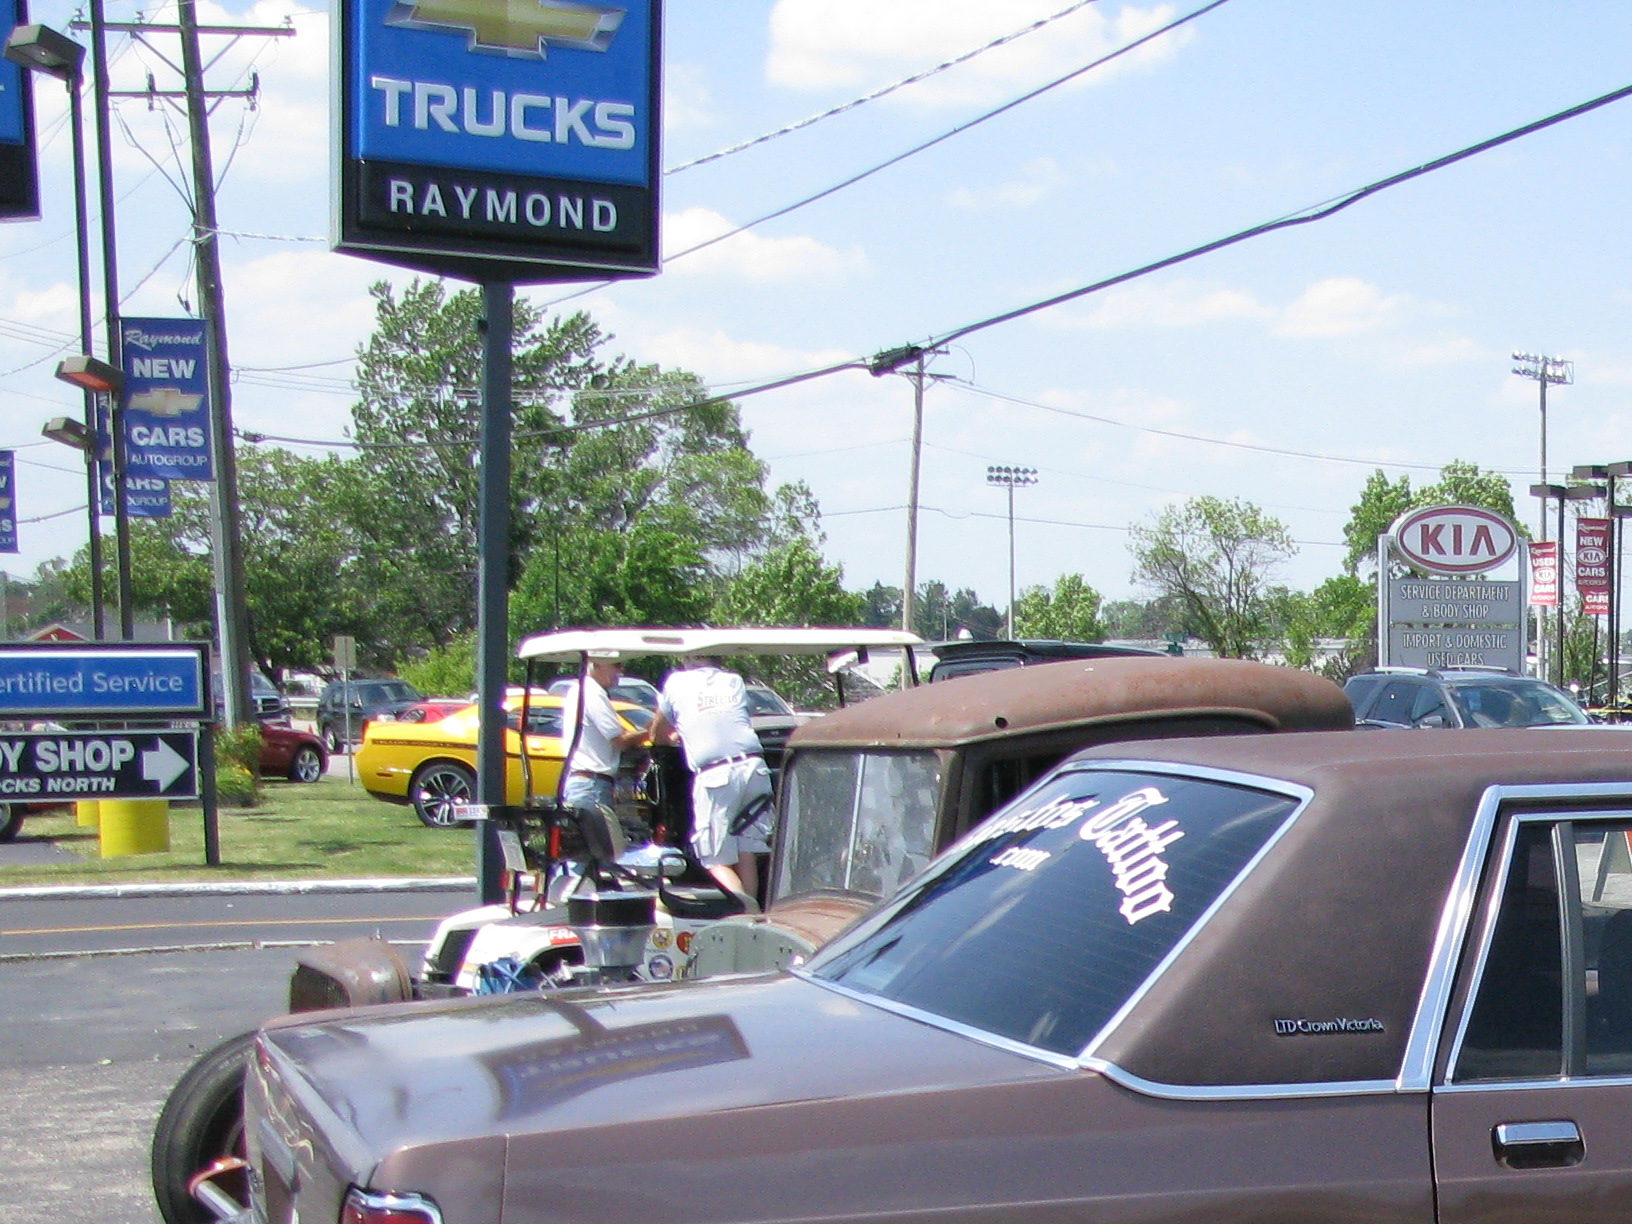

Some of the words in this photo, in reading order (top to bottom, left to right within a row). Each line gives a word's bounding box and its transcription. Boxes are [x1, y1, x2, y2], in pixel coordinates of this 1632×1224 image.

[371, 76, 636, 150] TRUCKS
[390, 180, 618, 232] RAYMOND
[125, 329, 203, 351] Raymond
[133, 358, 196, 379] NEW
[131, 427, 205, 447] CARS
[131, 453, 208, 466] AUTOGROUP
[1420, 524, 1497, 556] KIA
[1580, 536, 1604, 546] NEW
[1532, 557, 1555, 567] USED
[1583, 552, 1601, 560] KIA
[1578, 567, 1606, 577] CARS
[1400, 585, 1441, 599] SERVICE
[1445, 586, 1509, 600] DEPARTMENT
[1422, 606, 1430, 618] &
[1433, 604, 1459, 618] BODY
[1462, 604, 1489, 618] SHOP
[1403, 634, 1442, 648] IMPORT
[1445, 636, 1453, 648] &
[1456, 634, 1507, 649] DOMESTIC
[1427, 653, 1453, 666] USED
[1457, 653, 1484, 665] CARS
[92, 672, 183, 693] Service
[0, 740, 26, 773] Y
[35, 739, 135, 773] SHOP
[0, 777, 42, 793] CKS
[47, 776, 116, 793] NORTH
[1274, 1019, 1297, 1033] LTD
[1298, 1018, 1338, 1032] Crown
[1336, 1017, 1384, 1031] Victoria
